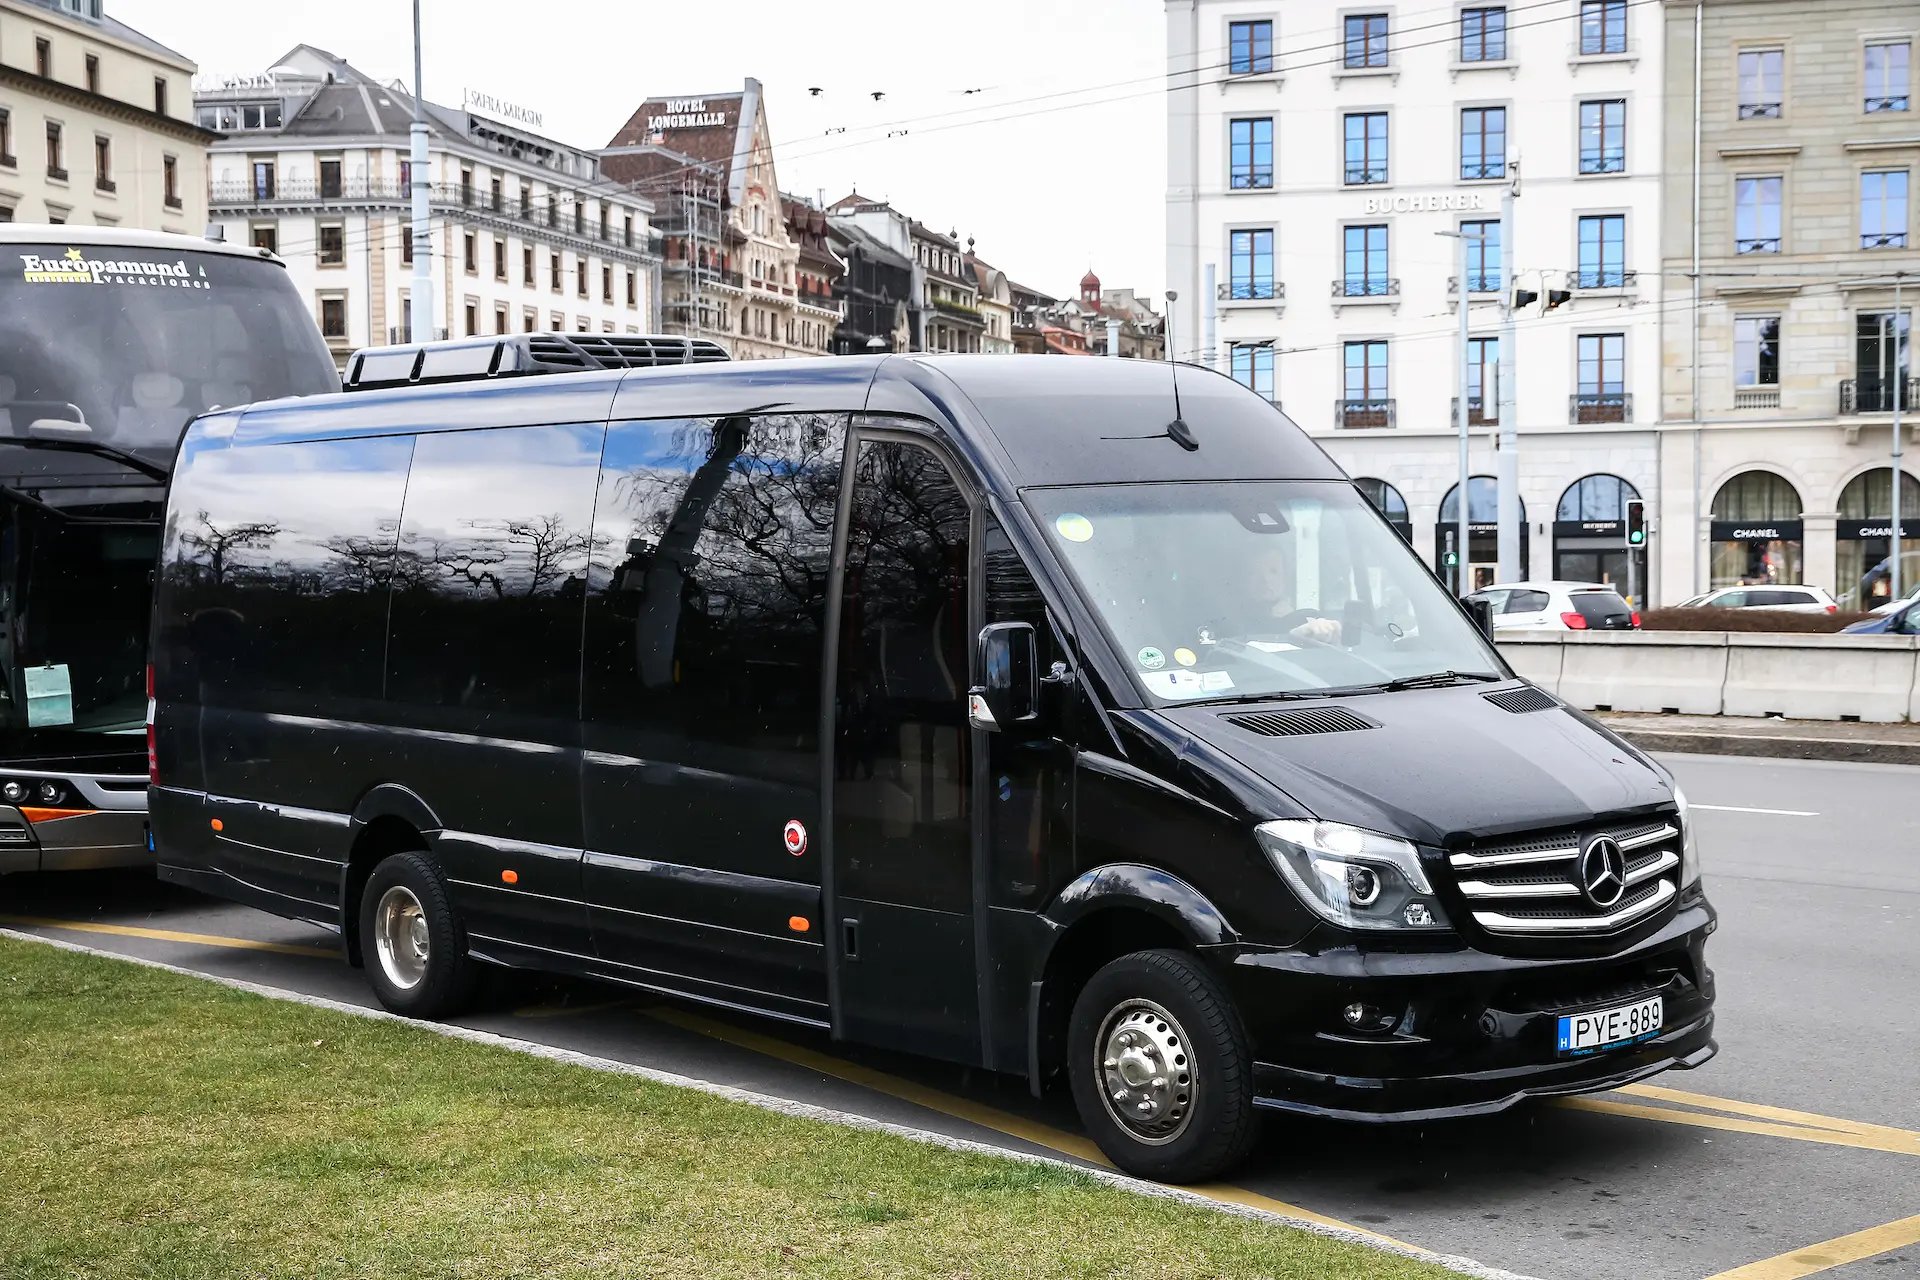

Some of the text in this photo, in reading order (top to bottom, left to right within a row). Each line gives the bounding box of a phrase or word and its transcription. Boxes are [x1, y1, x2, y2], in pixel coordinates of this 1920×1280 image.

[666, 99, 706, 114] HOTEL
[647, 112, 726, 129] LONGEMALLE
[1364, 192, 1484, 214] BUCHERER
[103, 275, 210, 290] vacaciones
[1733, 528, 1780, 538] CHANEL
[1859, 527, 1907, 537] CHANL
[1560, 1001, 1660, 1049] H PYE-889
